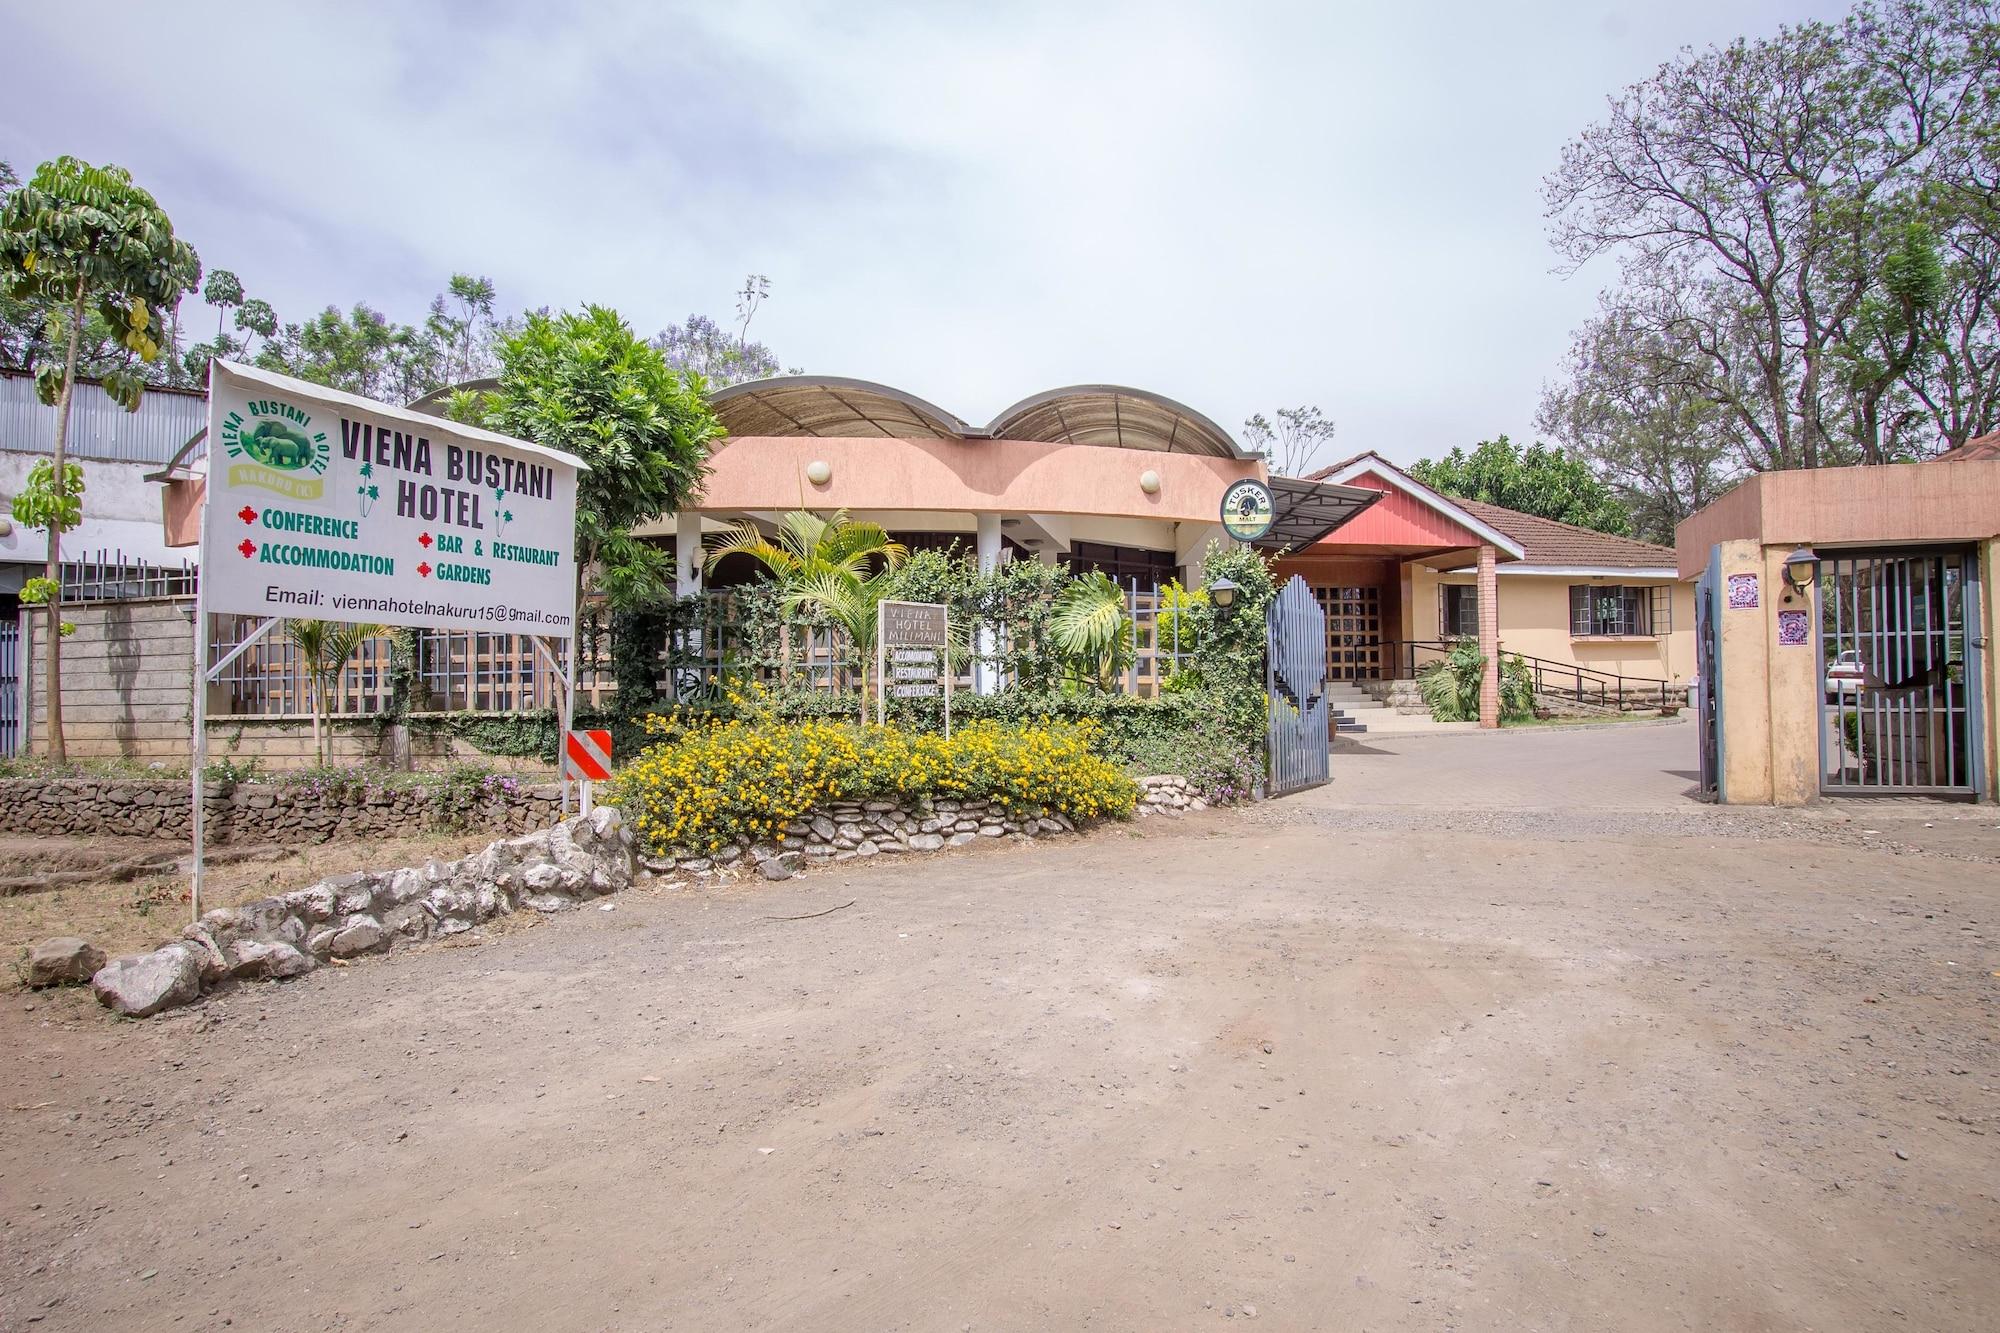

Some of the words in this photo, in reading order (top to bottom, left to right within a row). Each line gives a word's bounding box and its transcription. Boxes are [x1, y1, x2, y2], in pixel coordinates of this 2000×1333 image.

[222, 411, 245, 458] VIENA
[248, 400, 311, 427] BUSTANI
[309, 432, 330, 475] HOTEL
[341, 418, 432, 477] VIENA
[447, 444, 553, 501] BUSTANI
[397, 479, 483, 530] HOTEL
[1229, 487, 1266, 505] TUSKER
[262, 508, 359, 540] CONFERENCE
[259, 543, 395, 576] ACCOMMODATION
[437, 534, 463, 554] BAR
[474, 539, 483, 557] &
[493, 541, 560, 567] RESTAURANT
[436, 562, 491, 586] GARDENS
[265, 585, 324, 606] Email:
[333, 594, 570, 626] viennahotelnakuru15@gmail.com
[888, 631, 941, 642] MILIMANI
[896, 620, 932, 631] HOTEL
[895, 667, 934, 679] RESTAURANT
[896, 685, 936, 698] CONFERENCE
